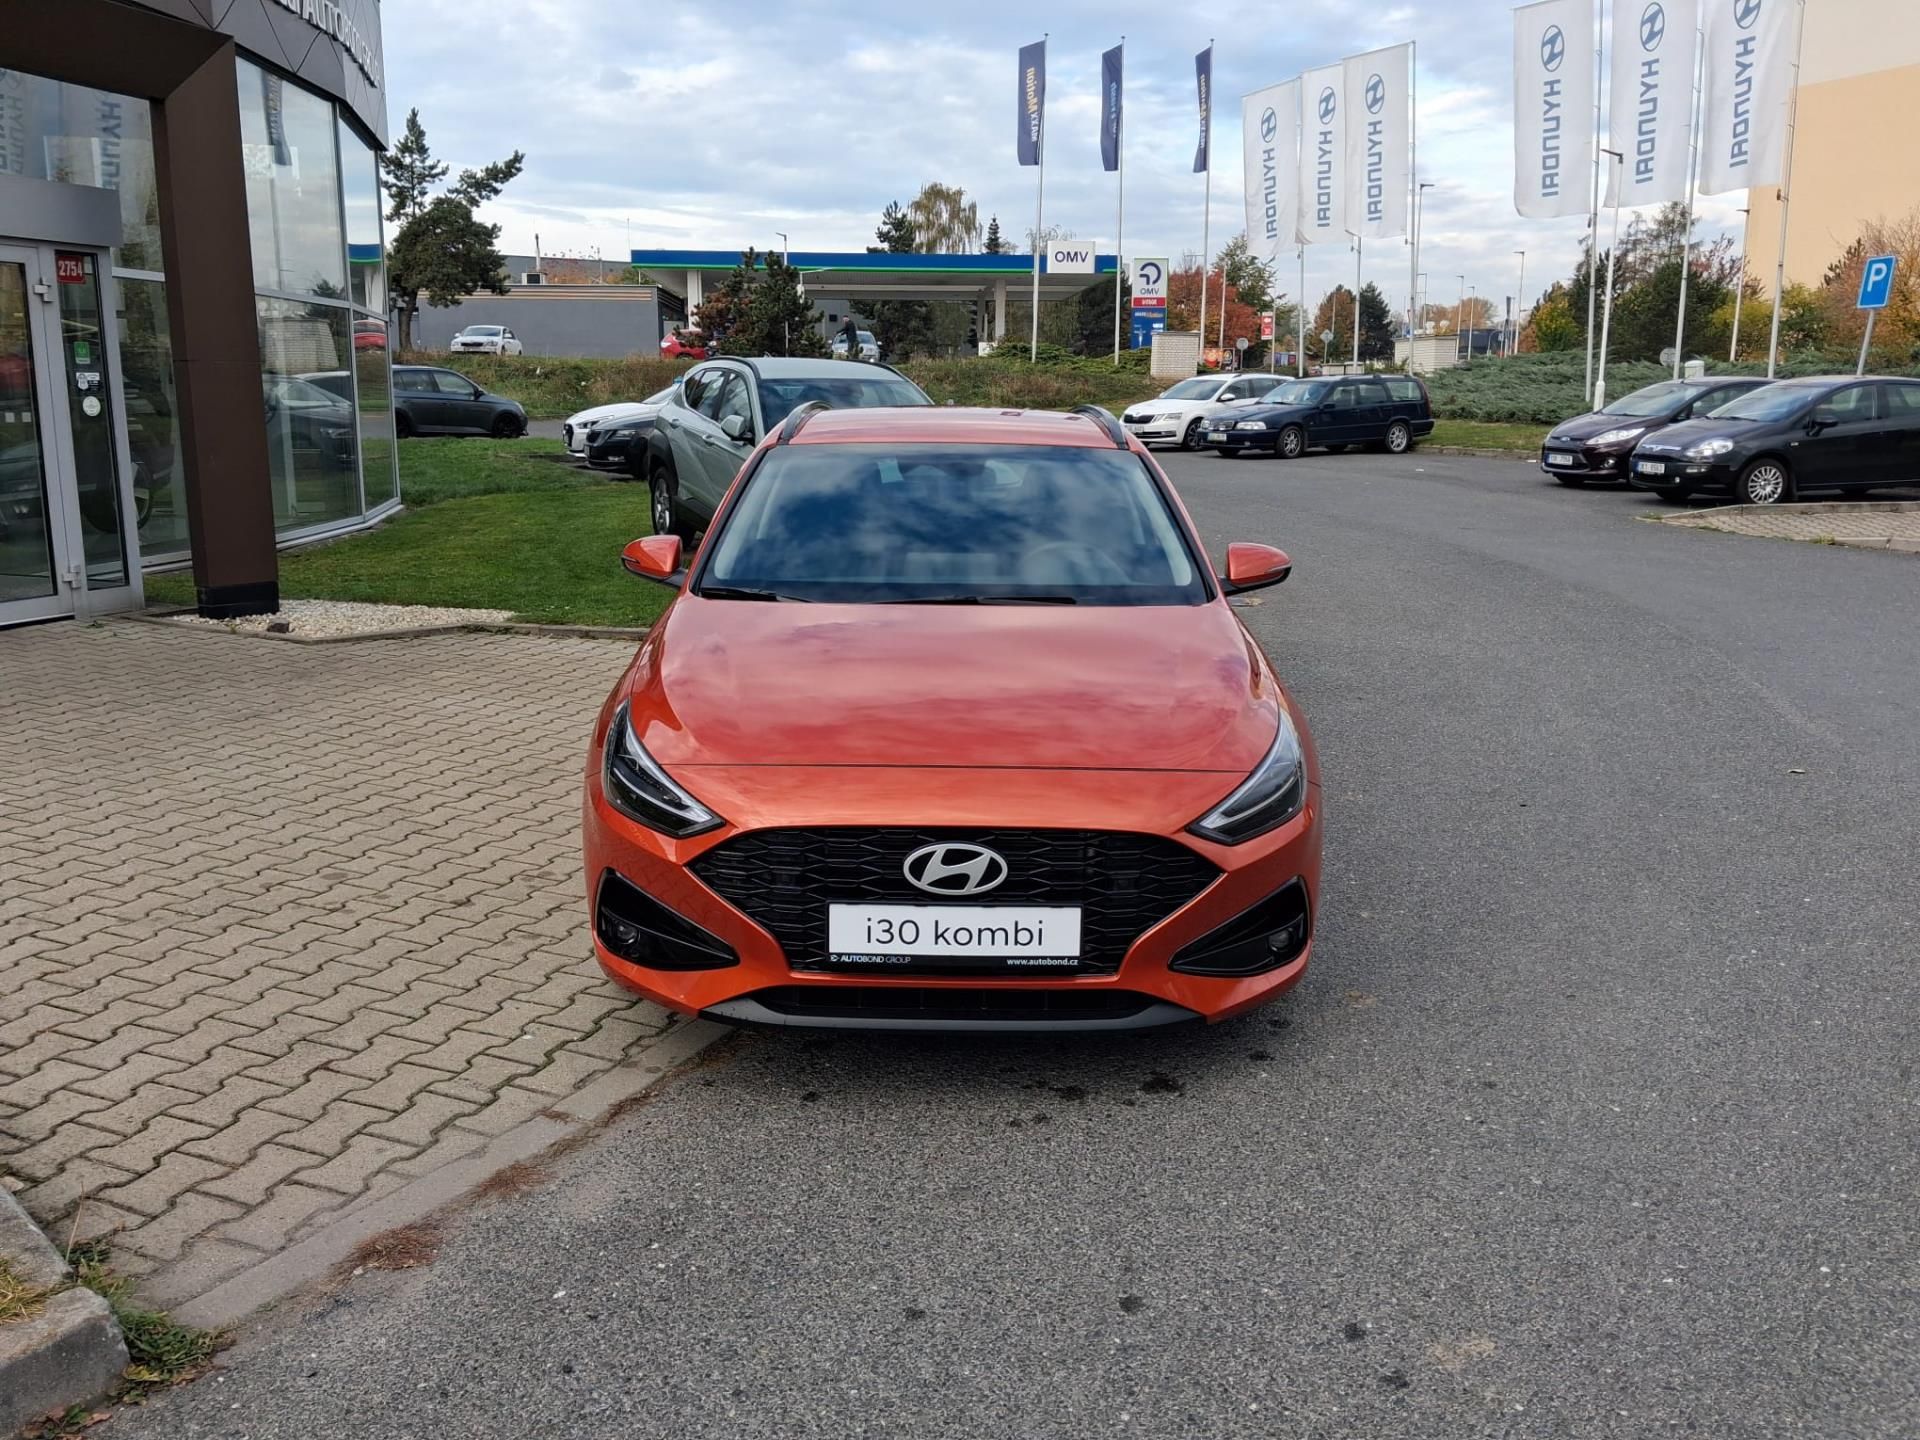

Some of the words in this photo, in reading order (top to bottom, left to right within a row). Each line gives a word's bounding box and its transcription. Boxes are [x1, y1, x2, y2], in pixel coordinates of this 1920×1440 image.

[1054, 250, 1089, 263] OMV
[58, 260, 83, 277] 2754
[1867, 262, 1888, 292] P
[1140, 287, 1160, 295] OMV
[866, 917, 920, 945] i30
[934, 919, 1043, 946] kombi
[840, 954, 885, 963] AUTOBOND
[886, 956, 911, 964] GROUP
[1006, 957, 1079, 966] www.autobond.cz
